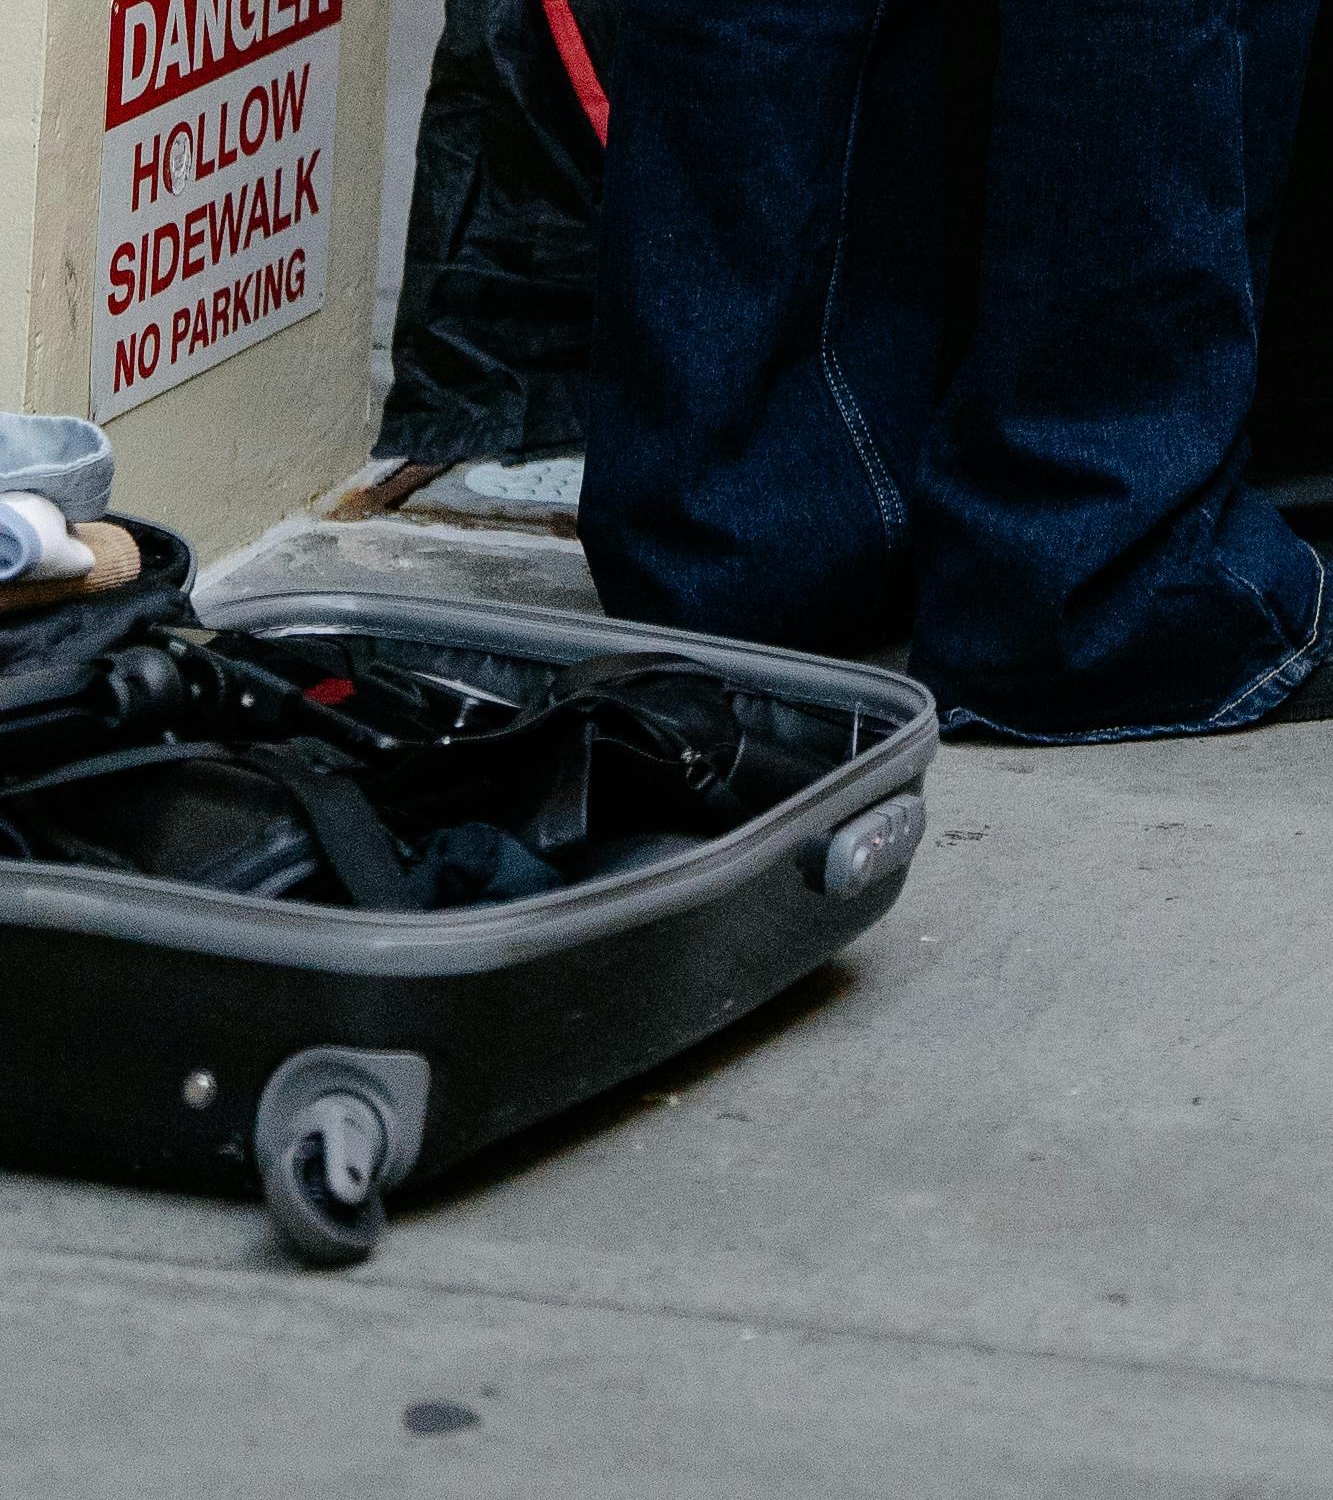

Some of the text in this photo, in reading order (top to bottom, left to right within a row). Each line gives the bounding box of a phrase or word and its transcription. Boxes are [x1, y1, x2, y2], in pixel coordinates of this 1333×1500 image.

[131, 64, 311, 212] HOLLOW
[108, 148, 321, 316] SIDEWALK
[113, 248, 306, 394] NO PARKING
